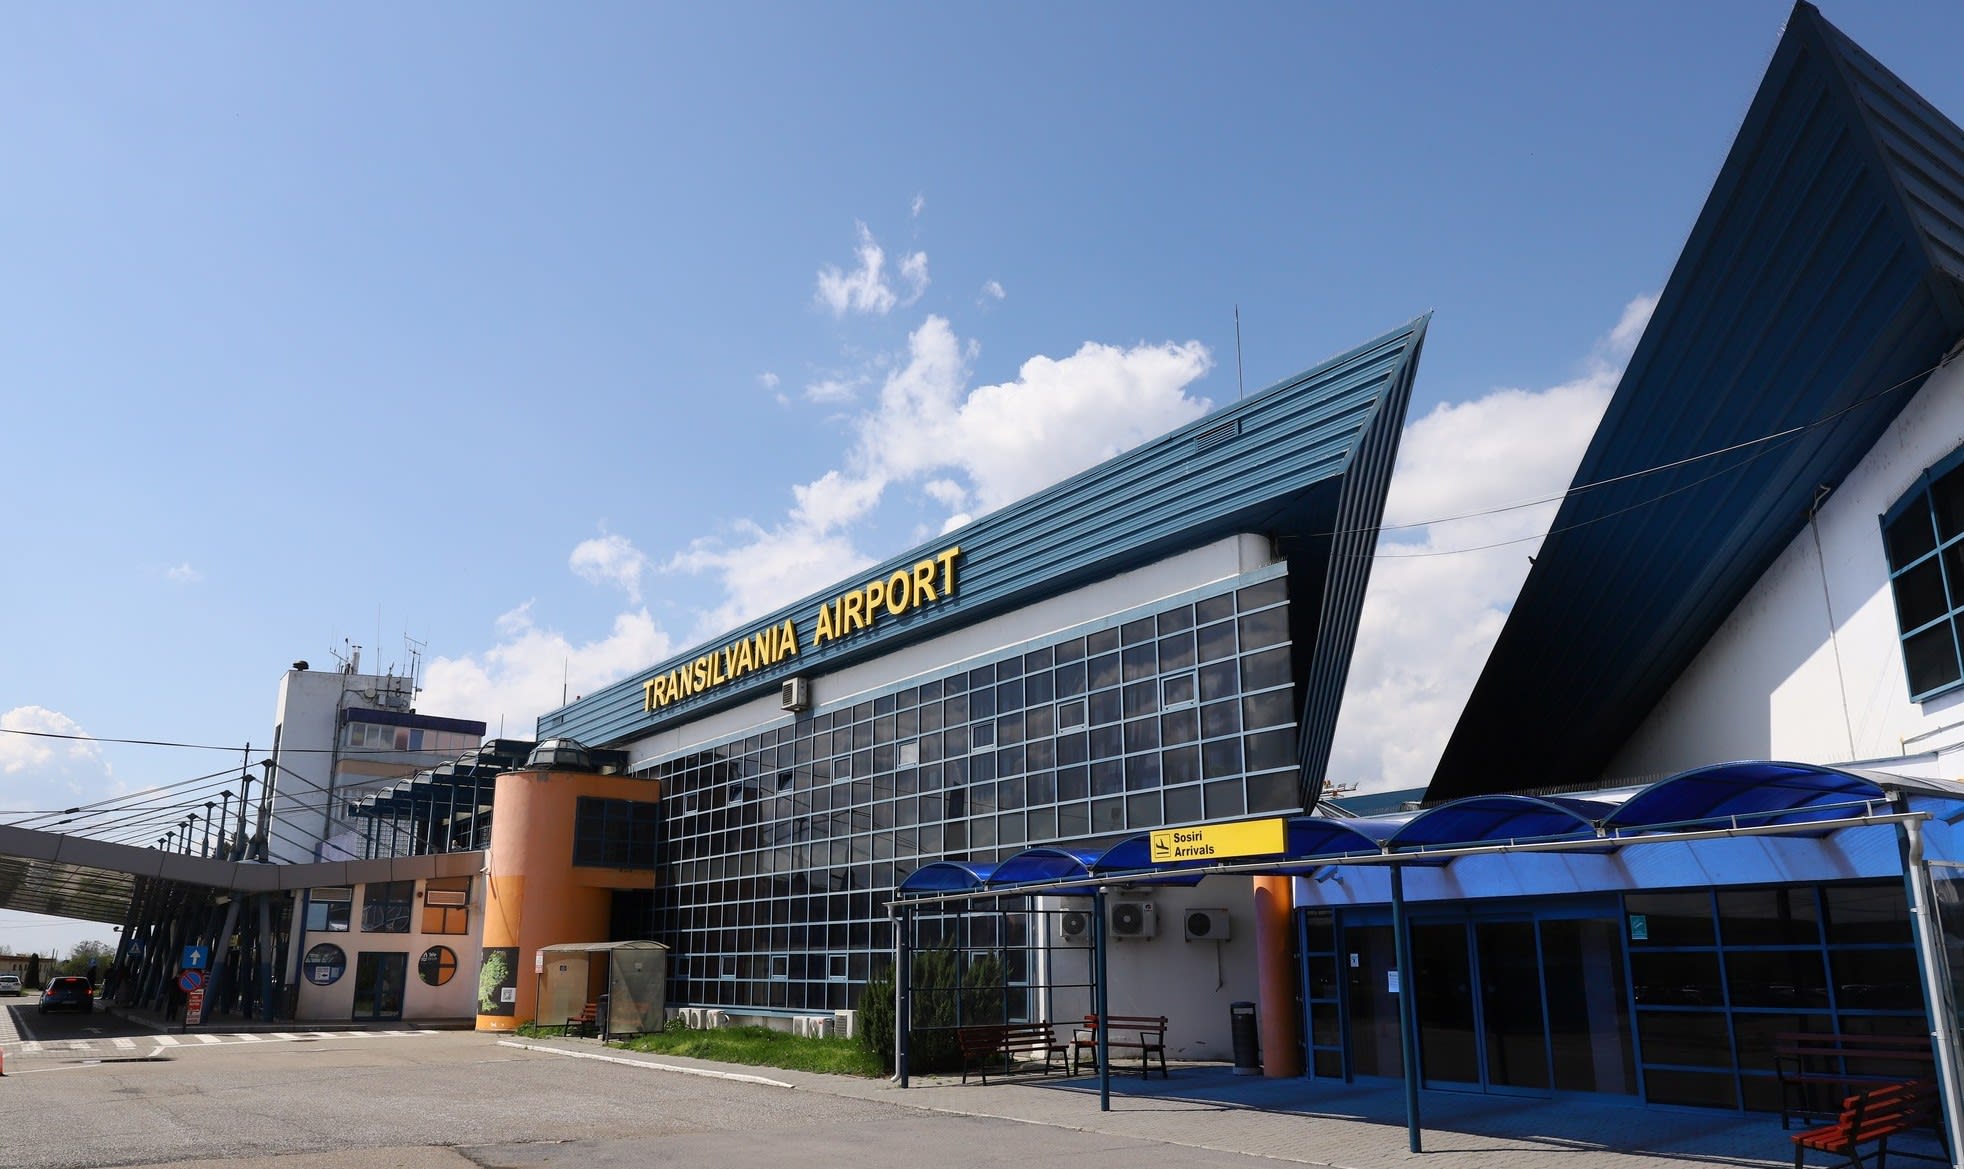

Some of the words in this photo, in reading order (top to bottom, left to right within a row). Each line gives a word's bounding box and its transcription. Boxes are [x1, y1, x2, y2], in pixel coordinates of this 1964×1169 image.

[642, 618, 798, 712] TRANSILVANIA
[813, 546, 961, 646] AIRPORT
[1174, 831, 1203, 843] Sosiri
[1175, 845, 1215, 857] Arrivals
